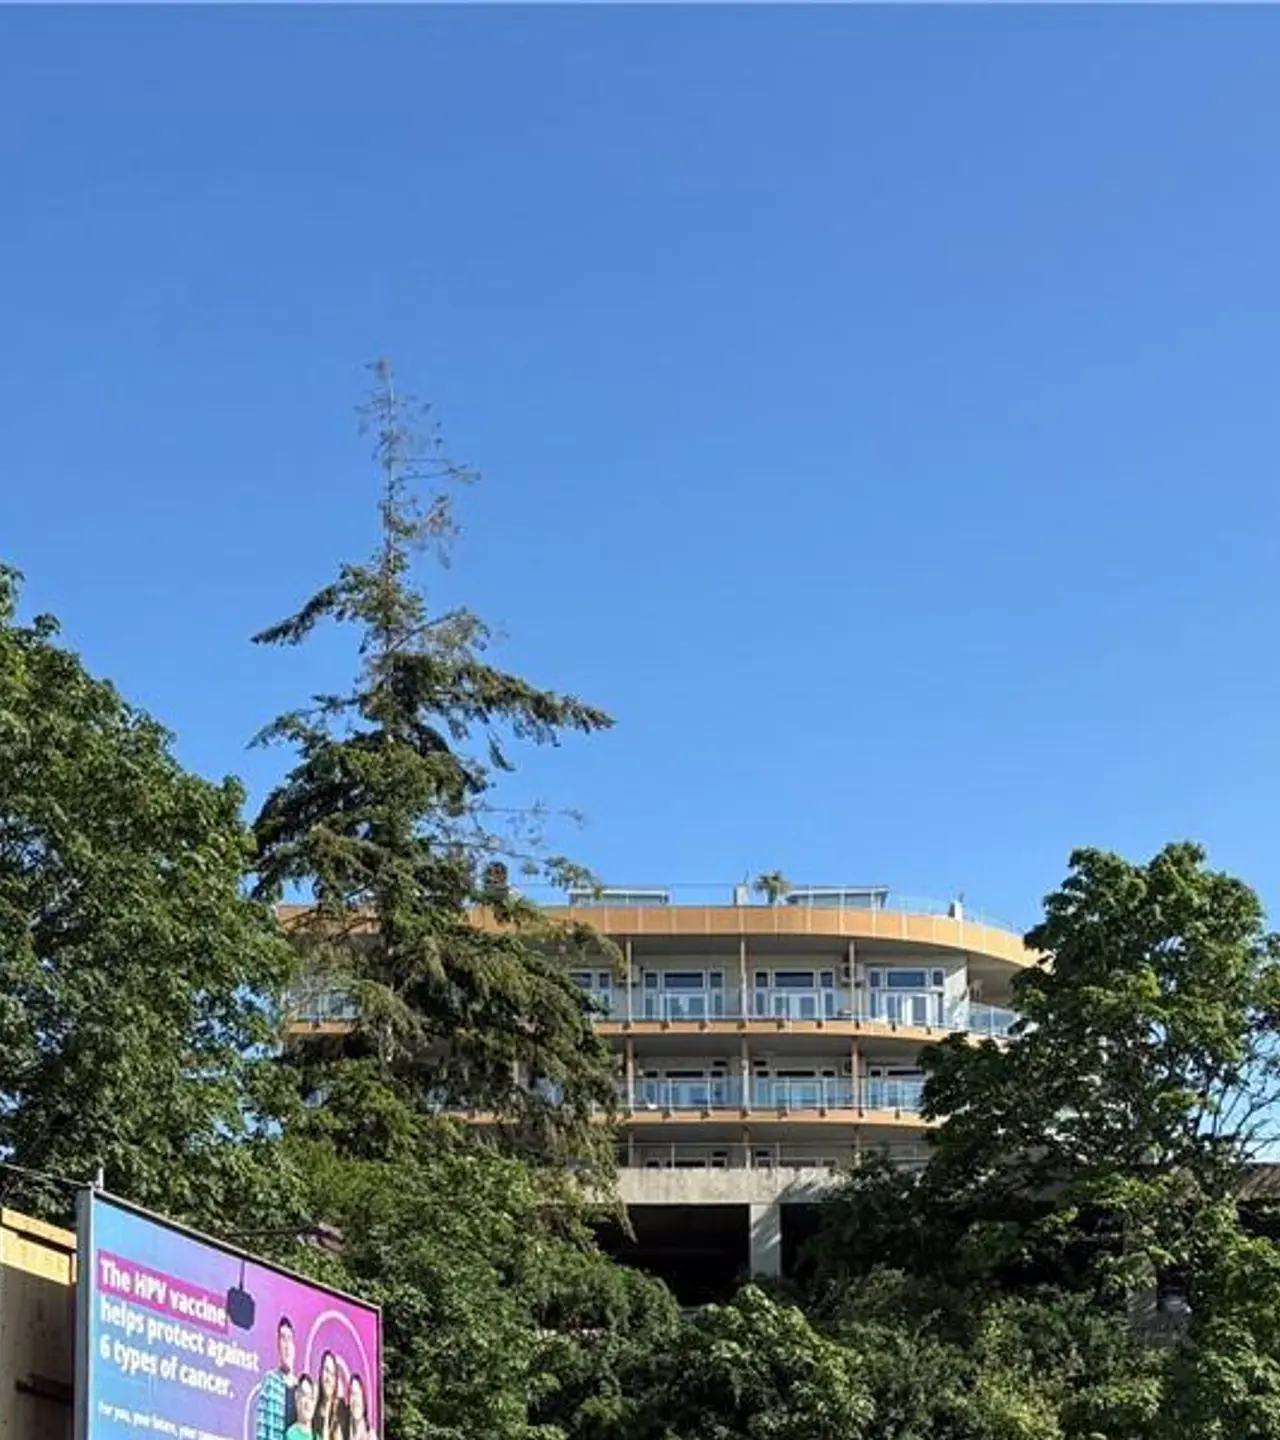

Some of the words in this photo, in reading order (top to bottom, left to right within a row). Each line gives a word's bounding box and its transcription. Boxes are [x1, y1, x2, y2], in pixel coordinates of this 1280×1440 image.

[100, 1259, 130, 1293] The
[135, 1271, 167, 1305] HPV
[169, 1288, 226, 1327] vaccine
[100, 1333, 111, 1359] 6
[114, 1339, 157, 1377] types
[160, 1355, 178, 1380] of
[180, 1364, 235, 1398] cancer.
[101, 1295, 144, 1338] helps
[148, 1316, 204, 1355] protect
[207, 1337, 260, 1373] against
